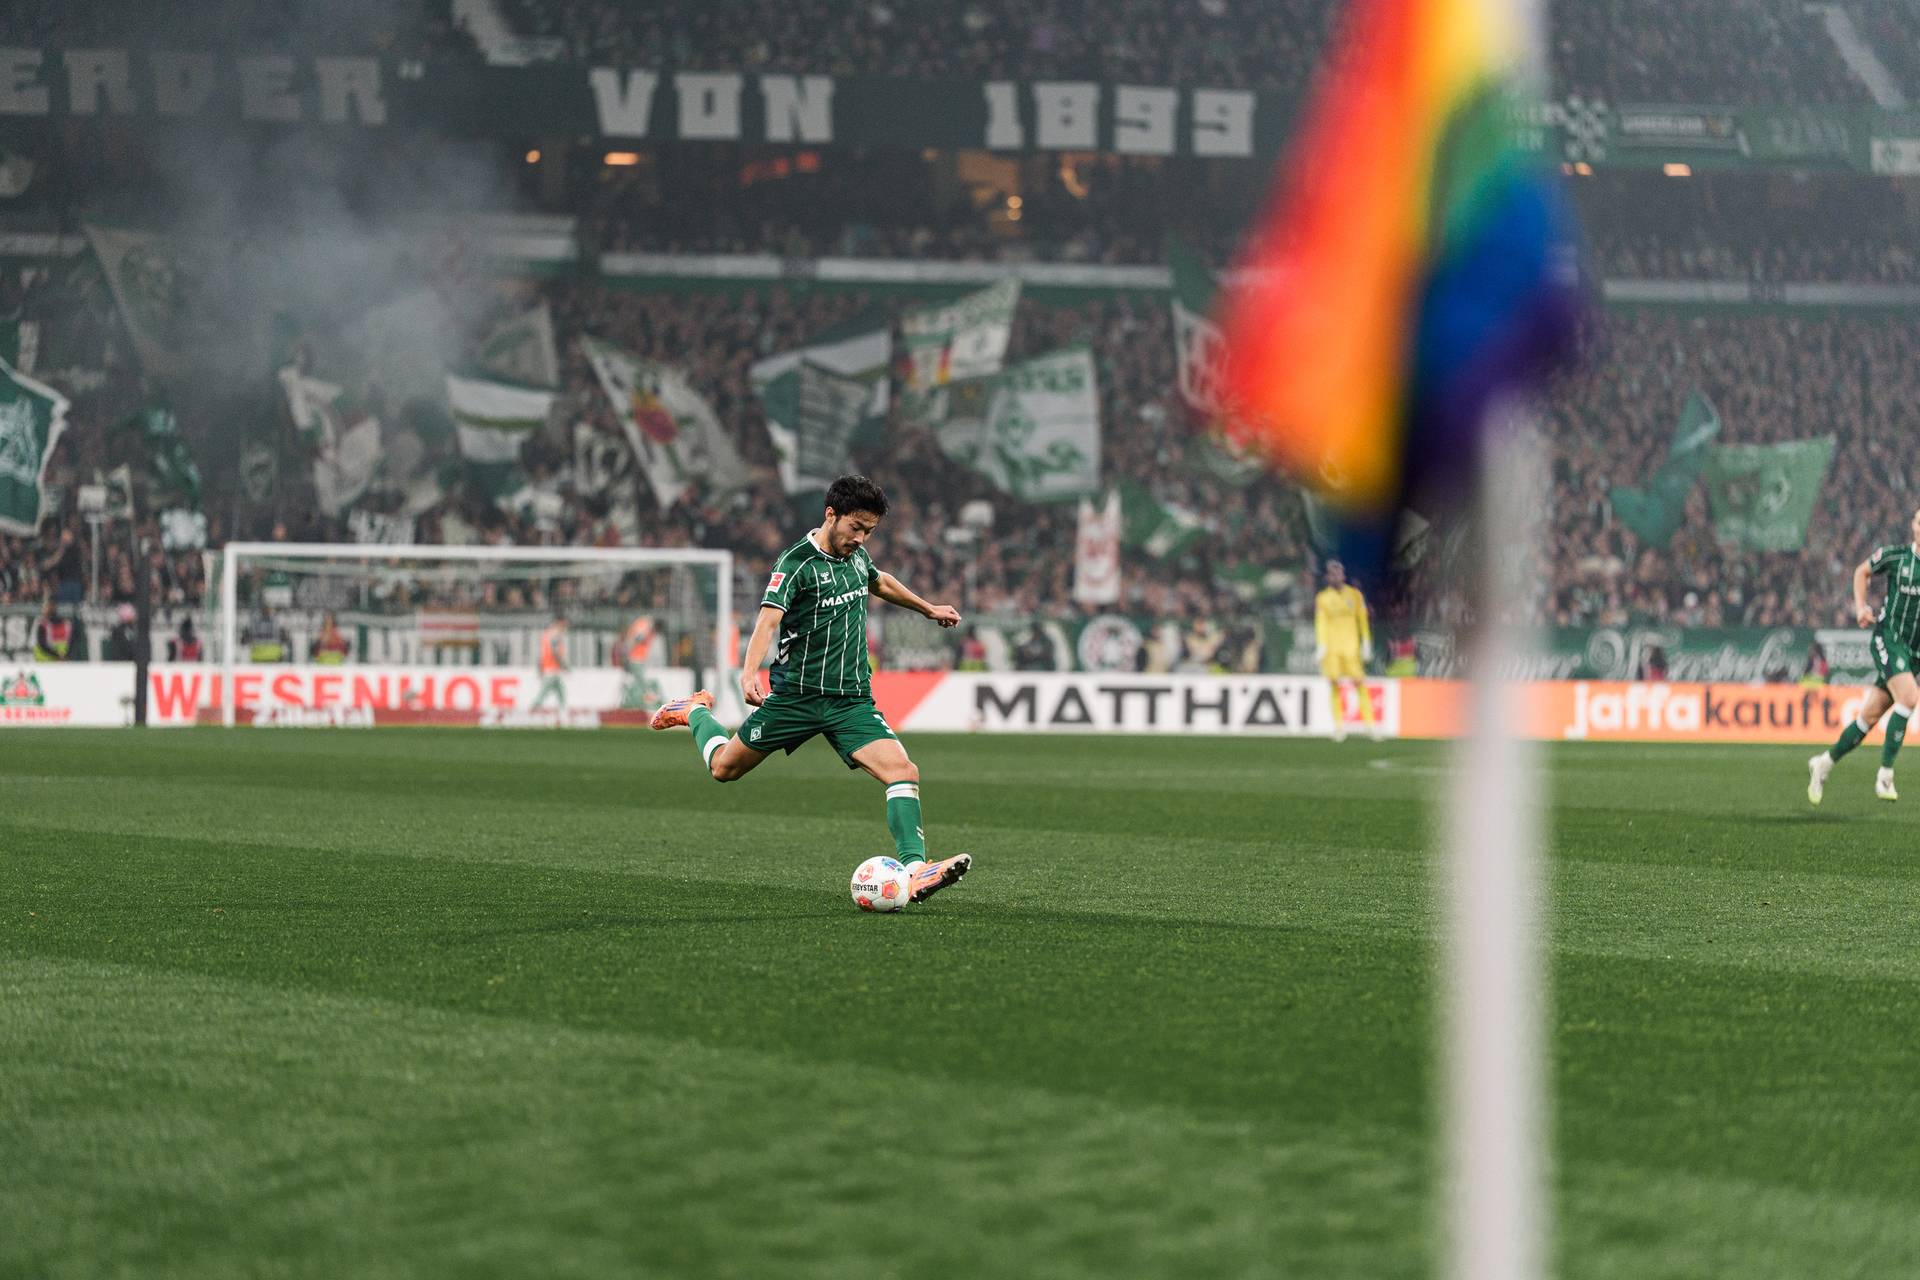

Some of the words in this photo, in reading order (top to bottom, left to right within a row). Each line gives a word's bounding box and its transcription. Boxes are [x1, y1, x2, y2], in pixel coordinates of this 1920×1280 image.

[589, 67, 834, 143] VON
[983, 80, 1257, 157] 1899
[974, 684, 1310, 726] MATTHÄI
